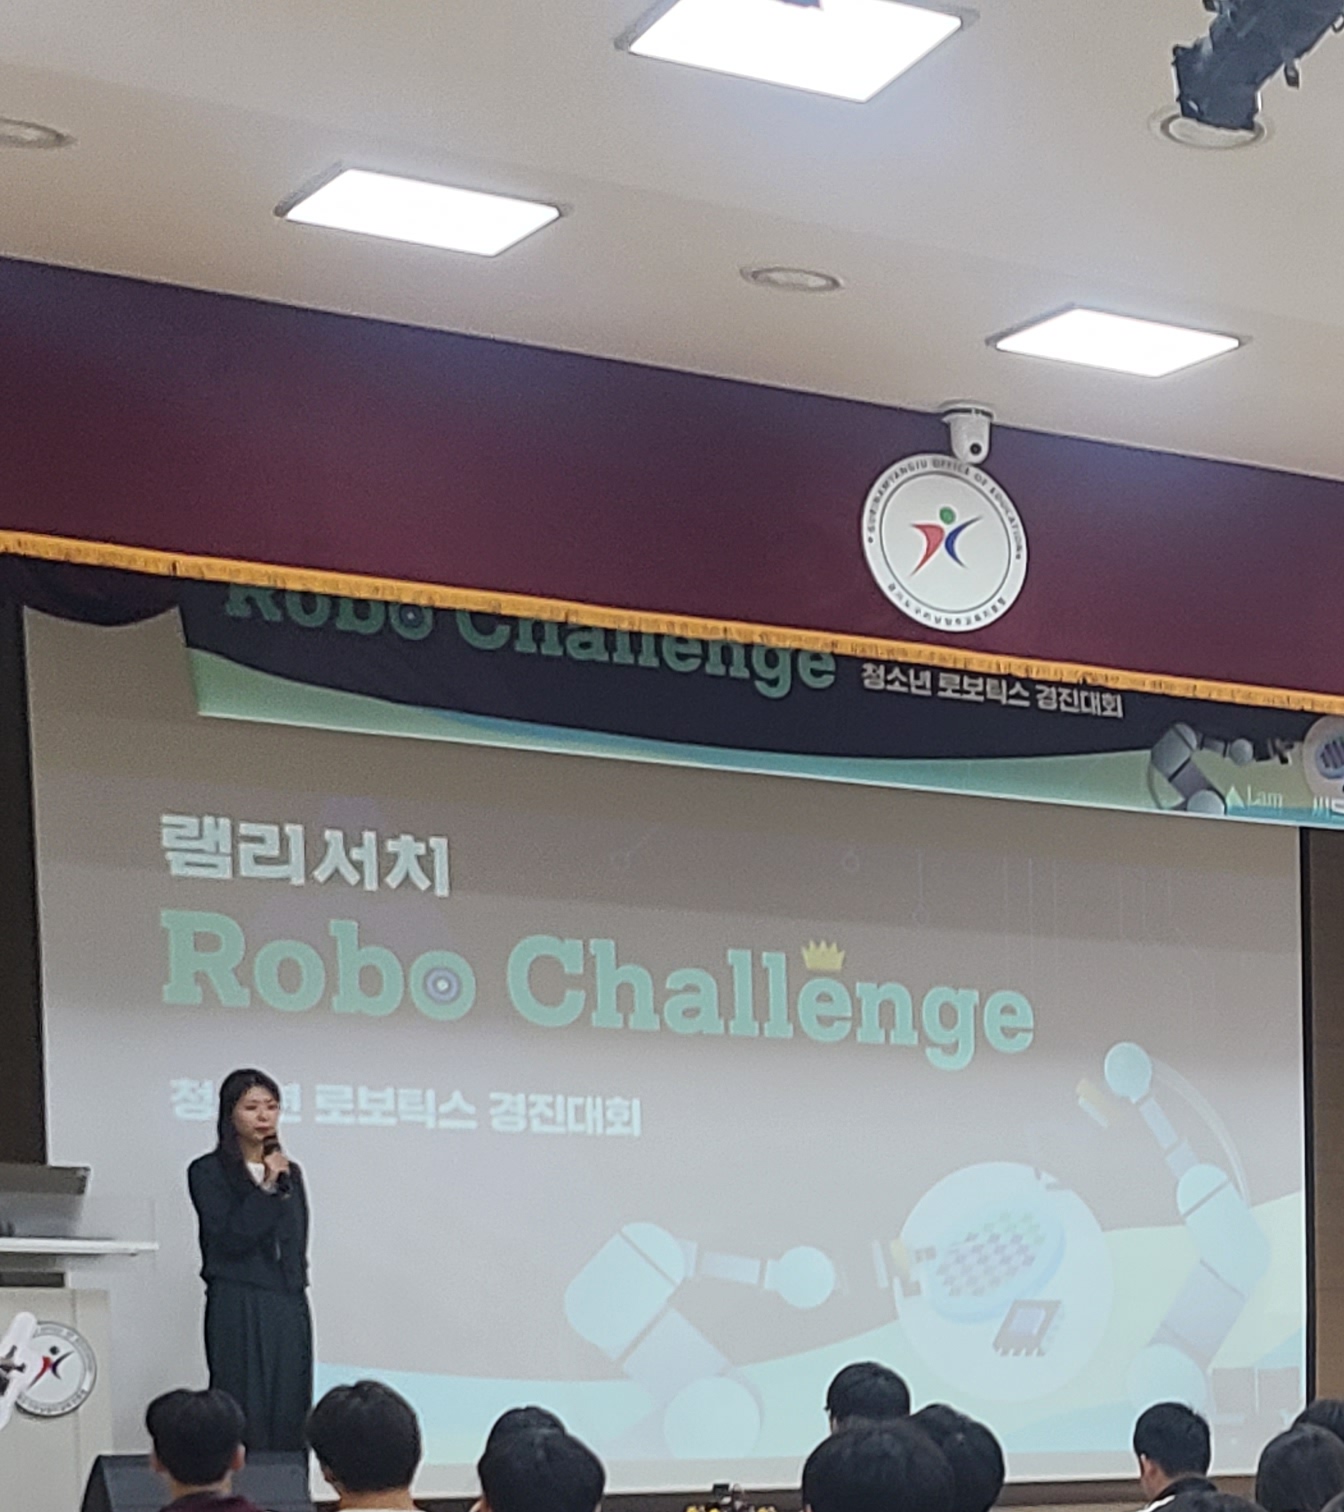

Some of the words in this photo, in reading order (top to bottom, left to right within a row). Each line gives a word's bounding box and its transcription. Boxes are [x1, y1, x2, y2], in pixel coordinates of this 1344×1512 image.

[861, 662, 932, 696] 청소년
[937, 673, 1030, 707] 로보틱스
[1035, 685, 1123, 718] 경진대회
[161, 813, 450, 897] 램리서치
[160, 910, 477, 1021] Robo
[508, 933, 1034, 1070] Challenge
[315, 1085, 477, 1129] 로보틱스
[489, 1091, 642, 1137] 경진대회
